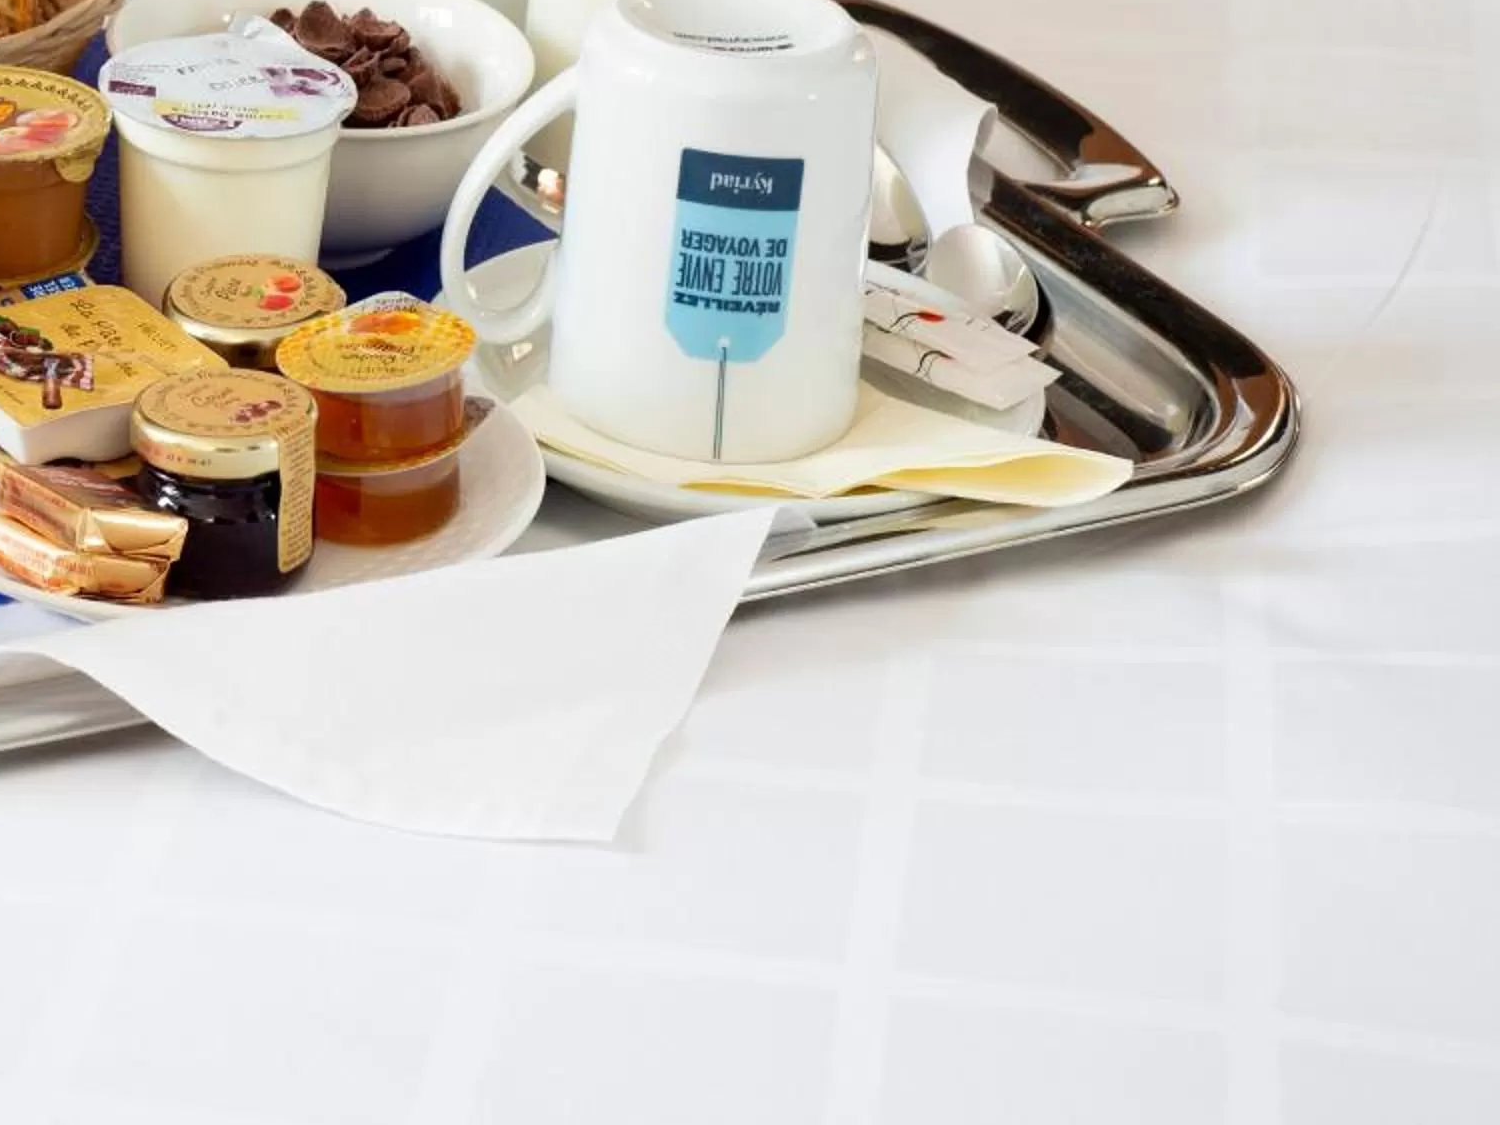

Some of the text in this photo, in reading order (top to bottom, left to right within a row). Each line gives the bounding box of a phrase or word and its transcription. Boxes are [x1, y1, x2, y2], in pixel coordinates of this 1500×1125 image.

[708, 170, 774, 196] Kyriad
[680, 228, 788, 258] DE VOYAGER
[675, 252, 784, 296] VOTRE ENVIE
[673, 292, 781, 317] RÉVEILLEZ
